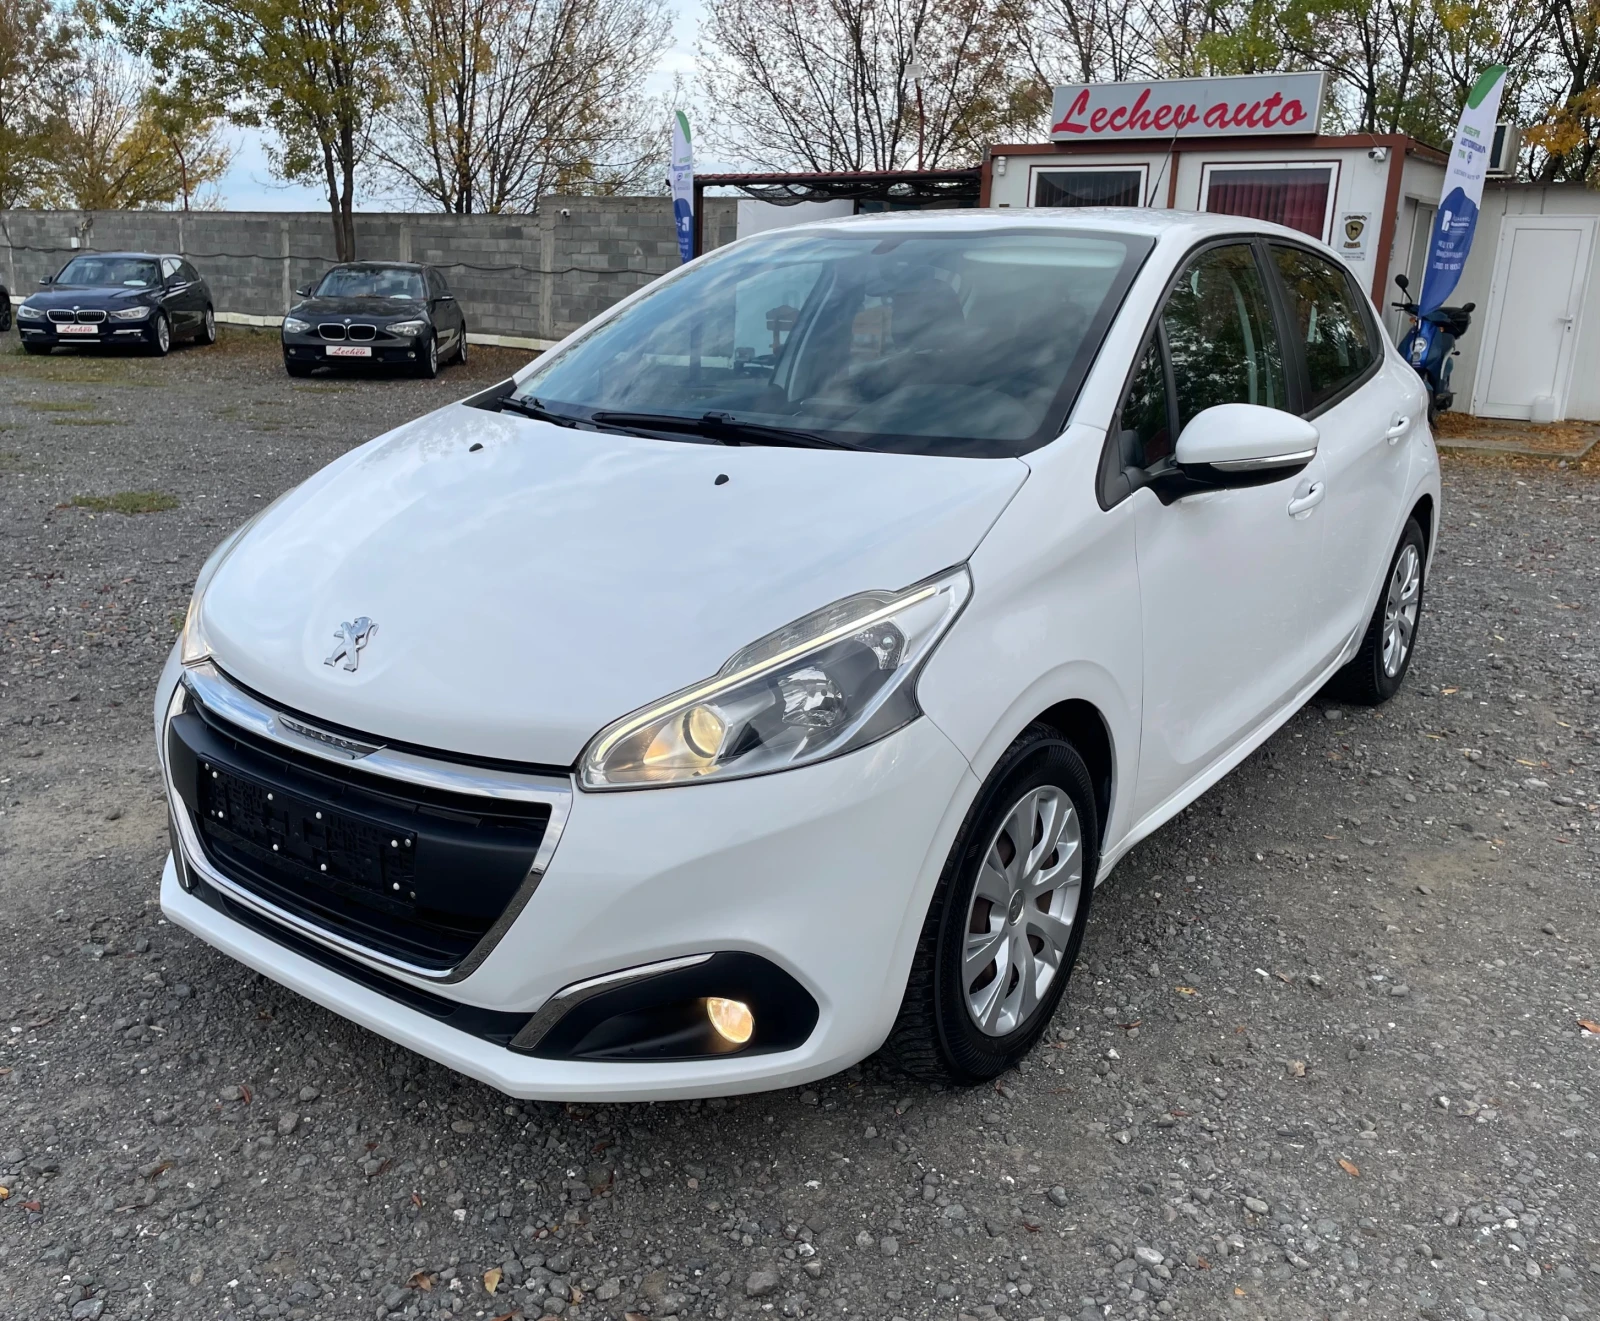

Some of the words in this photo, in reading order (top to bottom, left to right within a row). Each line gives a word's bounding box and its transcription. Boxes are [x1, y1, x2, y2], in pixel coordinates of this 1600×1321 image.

[1051, 88, 1199, 134] Lechev
[1203, 92, 1307, 129] auto
[332, 346, 366, 355] Lechev
